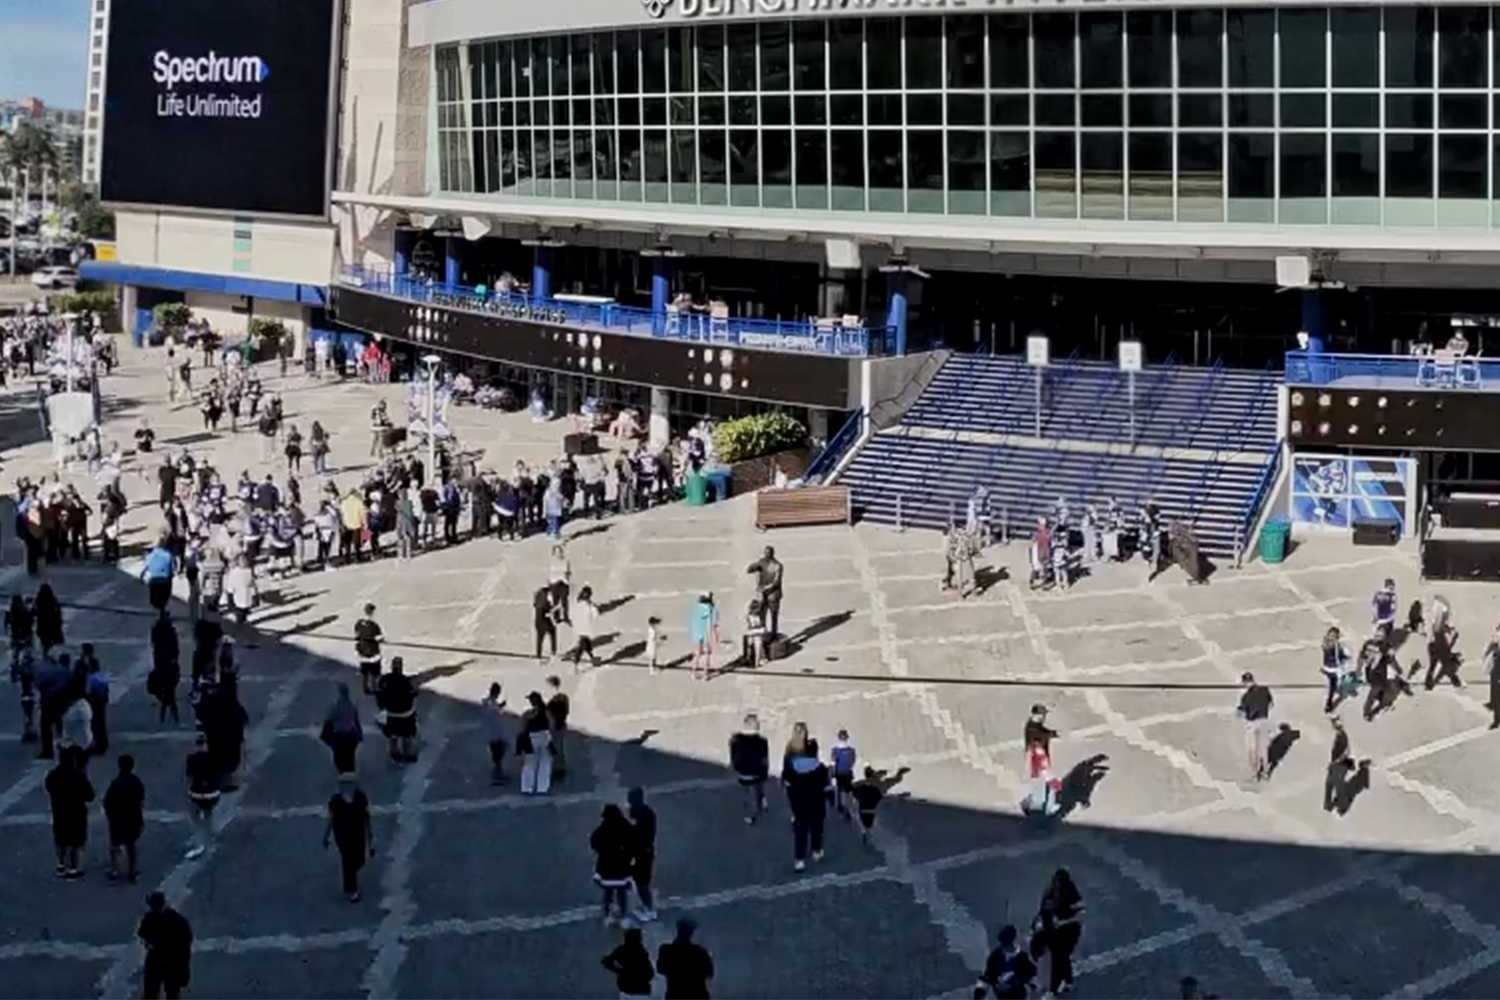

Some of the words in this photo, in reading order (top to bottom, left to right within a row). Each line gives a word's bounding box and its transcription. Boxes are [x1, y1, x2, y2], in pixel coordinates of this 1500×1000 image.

[153, 50, 262, 90] Spectrum
[158, 92, 185, 117] Life
[186, 92, 262, 118] Unlimited
